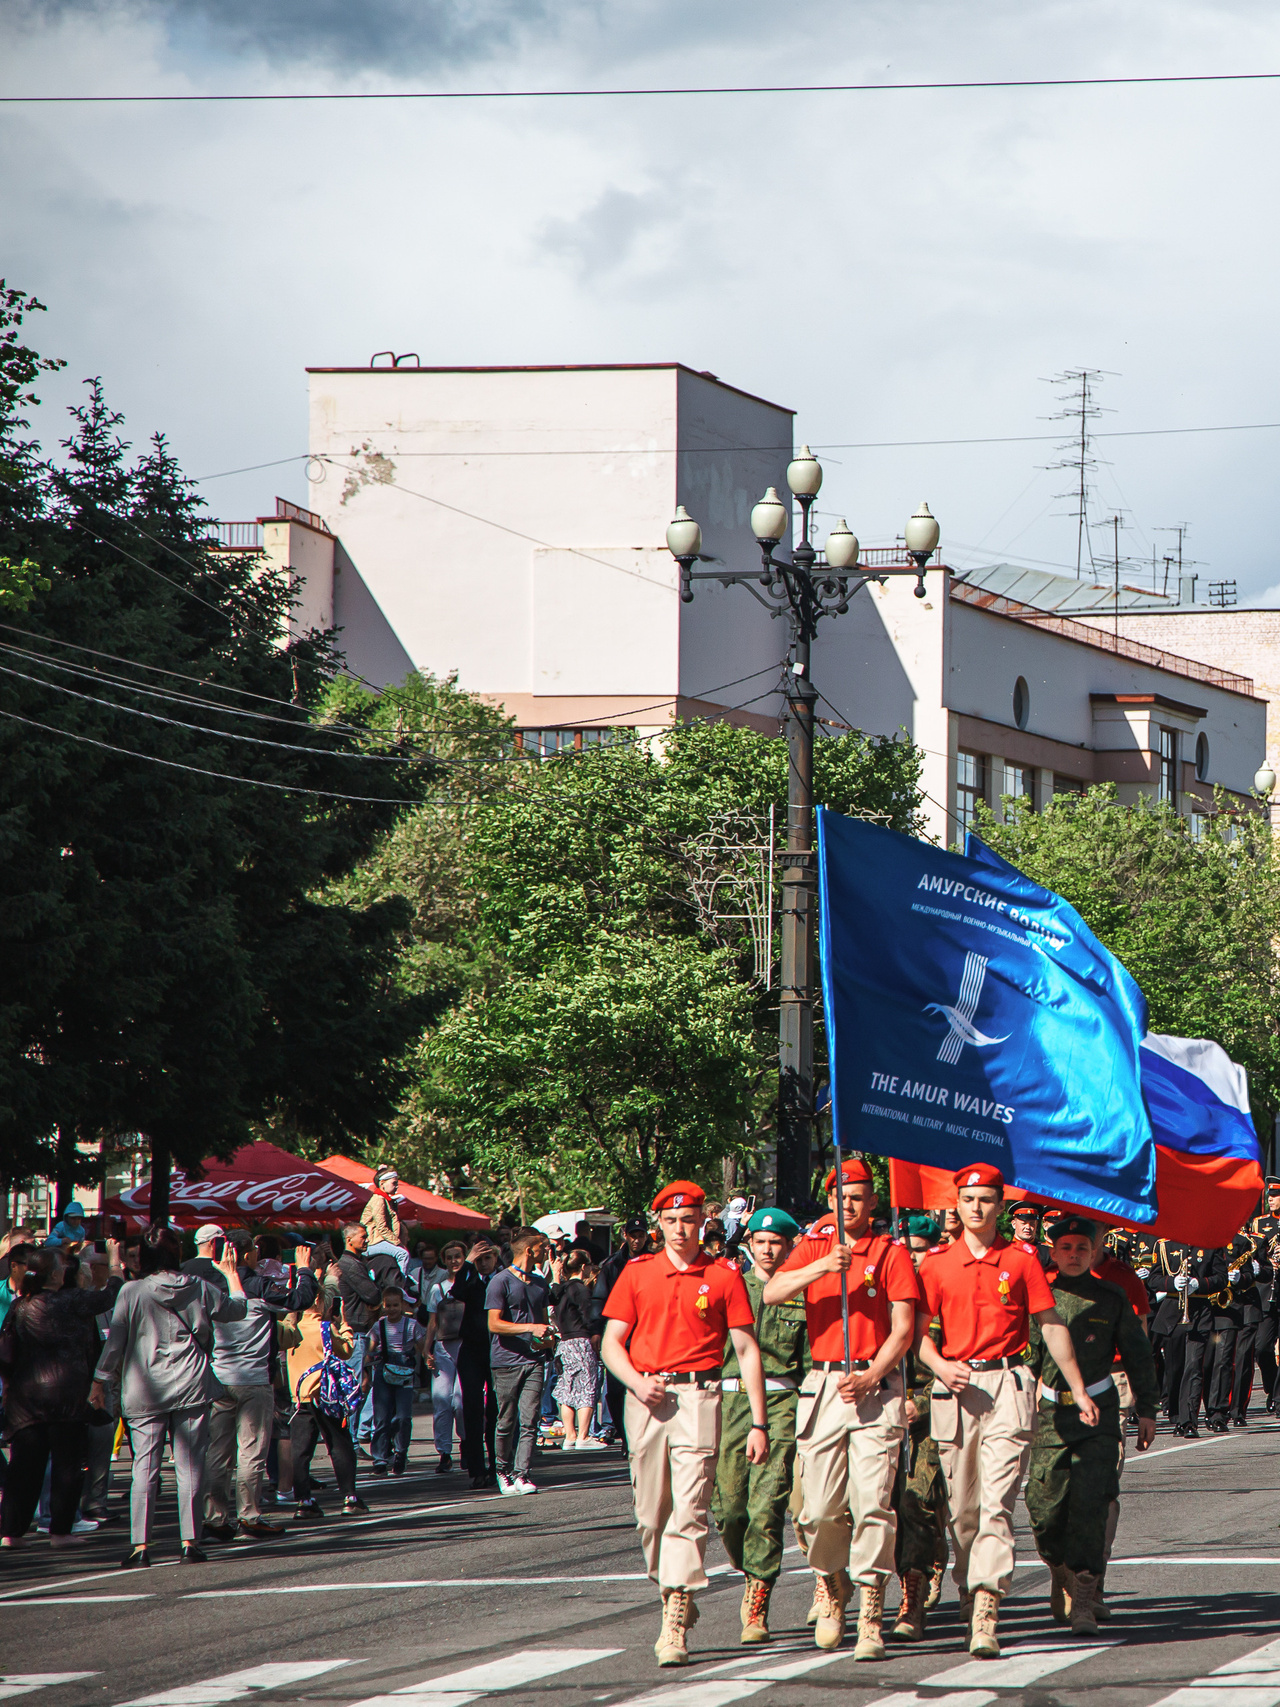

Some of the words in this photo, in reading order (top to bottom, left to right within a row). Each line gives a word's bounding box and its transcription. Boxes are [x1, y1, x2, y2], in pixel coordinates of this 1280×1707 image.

[917, 873, 1007, 914] АМУРСКИЕ
[911, 903, 962, 921] МЕЖДУНАРОДНЫЙ
[962, 915, 1031, 947] ВОЕННО-МУЗЫКАЛЬНЫЙ
[870, 1071, 899, 1095] THE
[900, 1079, 949, 1107] AMUR
[953, 1091, 1016, 1124] WAVES
[861, 1102, 909, 1123] INTERNATIONAL
[912, 1115, 944, 1131] MILITARY
[945, 1122, 970, 1138] MUSIC
[971, 1129, 1004, 1147] FESTIVAL
